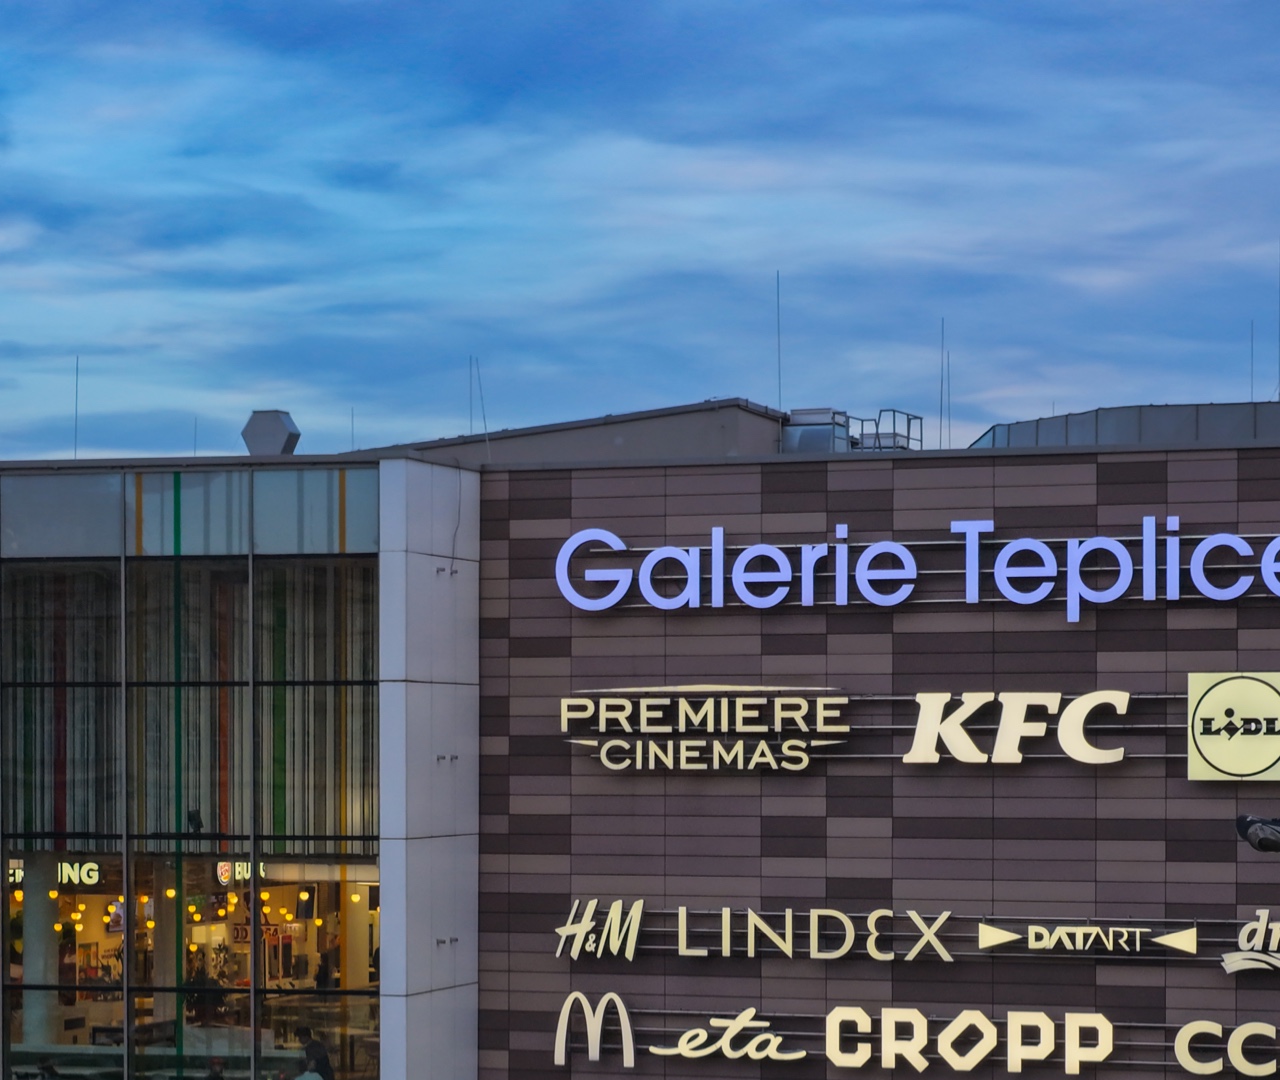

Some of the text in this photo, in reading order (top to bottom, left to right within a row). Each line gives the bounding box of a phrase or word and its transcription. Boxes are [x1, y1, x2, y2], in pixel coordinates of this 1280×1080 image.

[556, 525, 916, 611] Galerie
[560, 697, 850, 733] PREMIERE
[903, 690, 1130, 764] KFC
[599, 740, 809, 770] CINEMAS
[555, 899, 643, 962] H&M
[676, 907, 953, 962] LINDEX
[1028, 925, 1151, 952] DATART
[649, 1007, 806, 1061] eta
[826, 1007, 1113, 1075] CROPP
